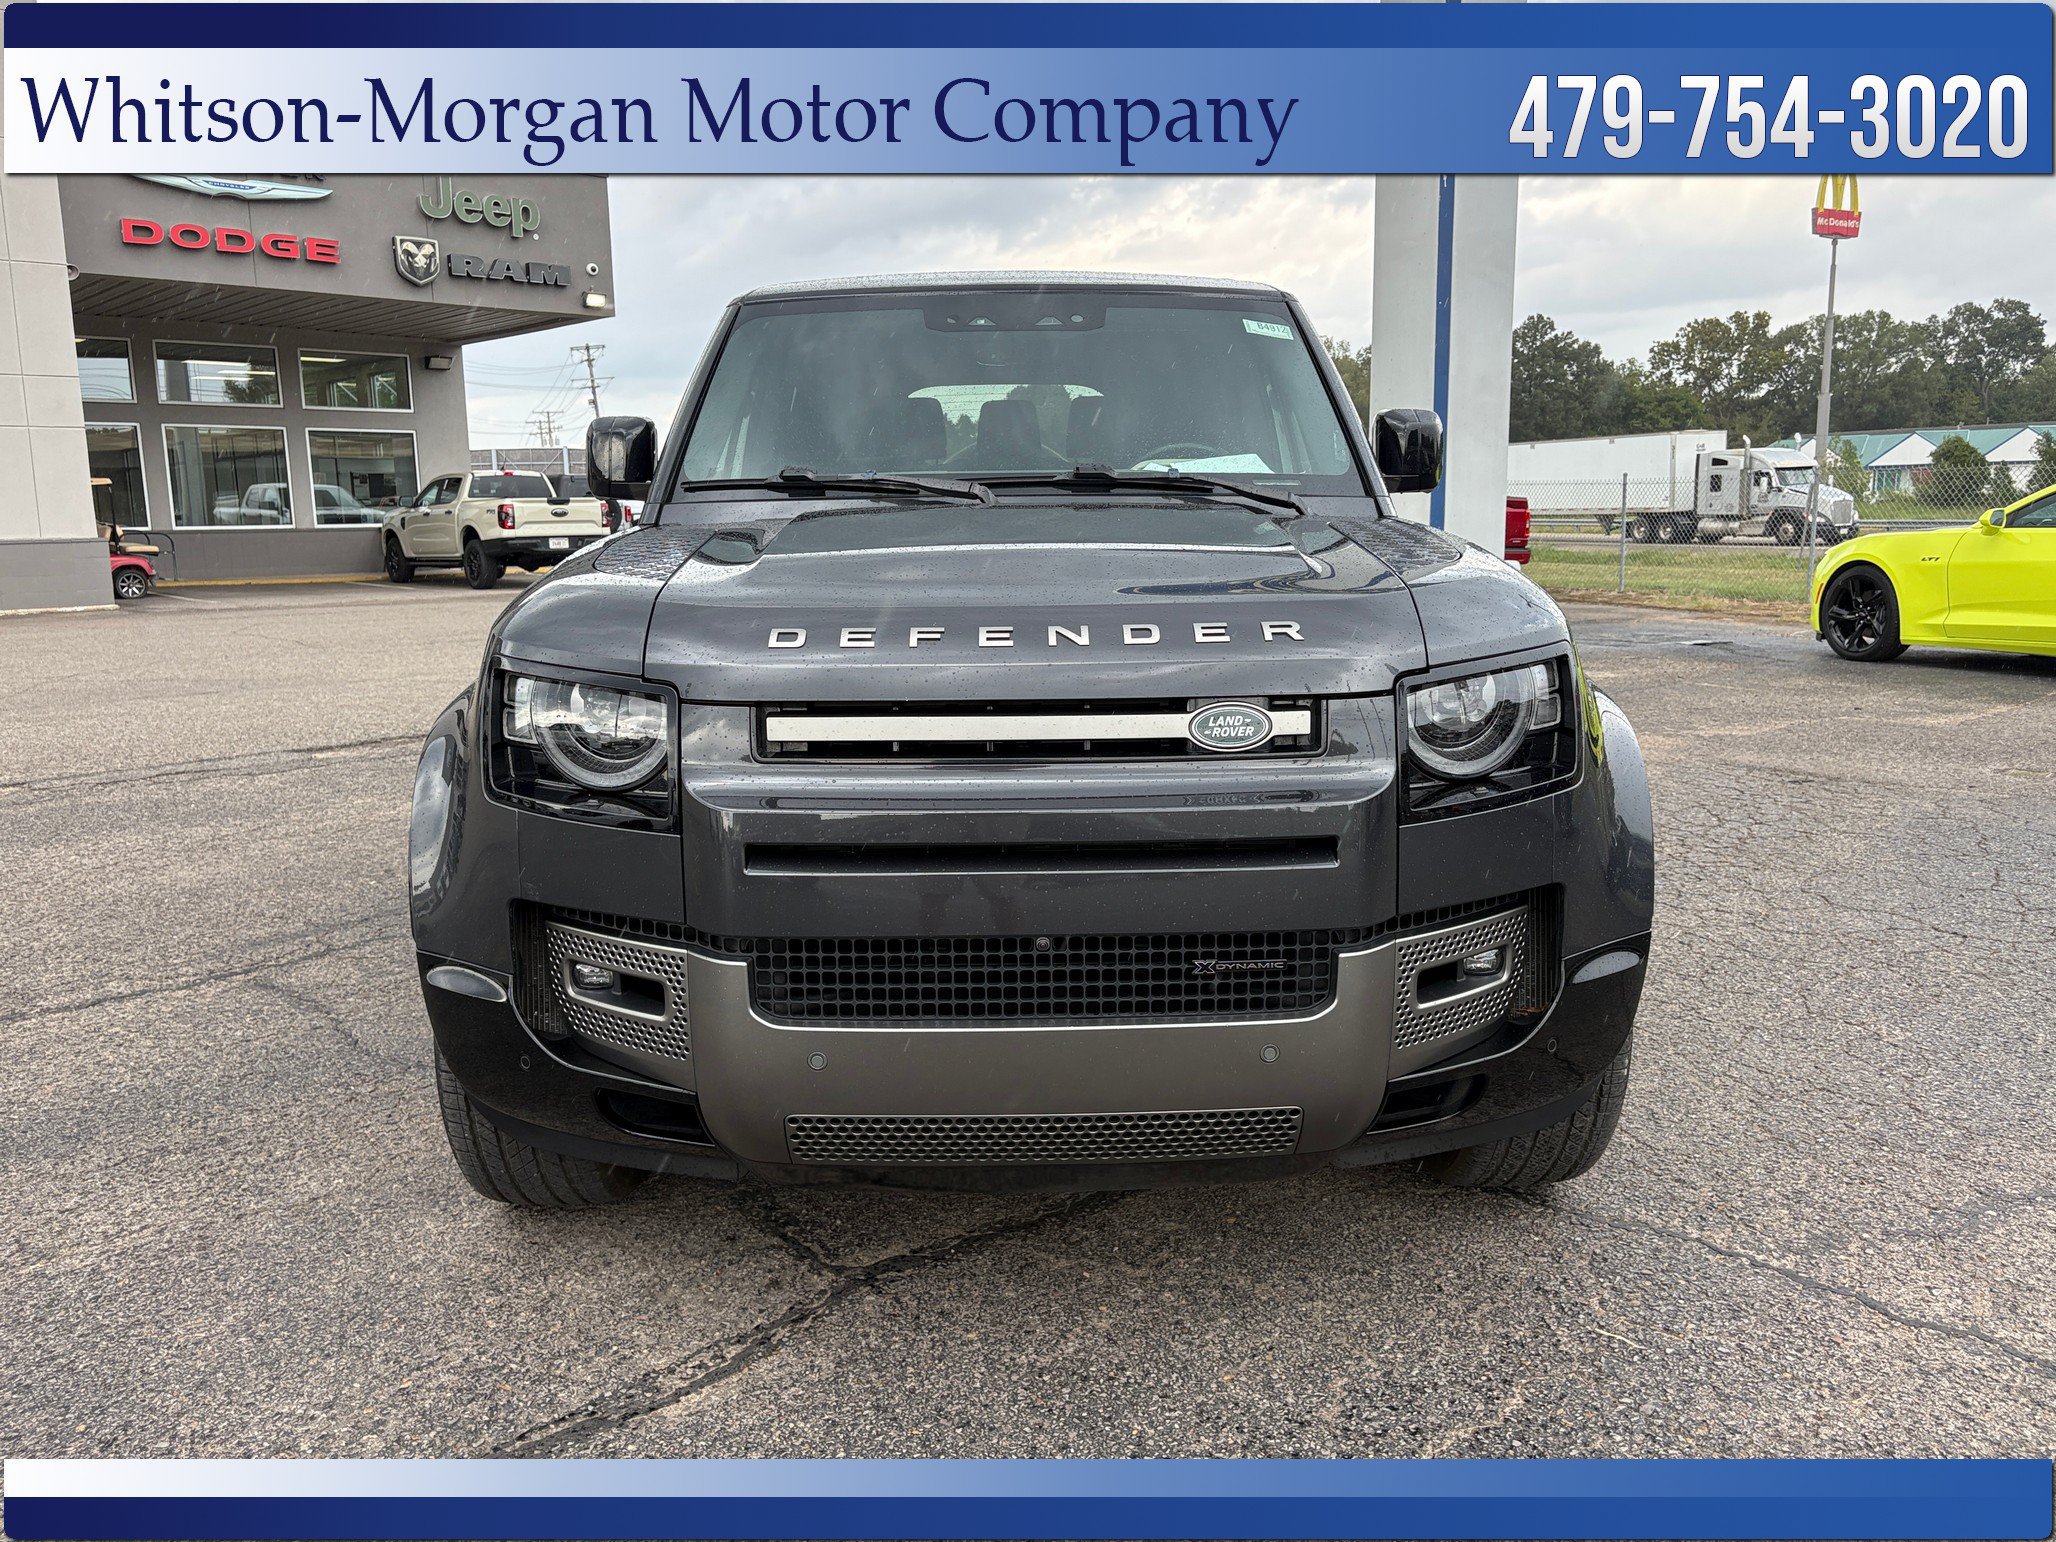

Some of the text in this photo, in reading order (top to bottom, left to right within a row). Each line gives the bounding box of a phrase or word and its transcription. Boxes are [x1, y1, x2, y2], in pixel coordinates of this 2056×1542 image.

[418, 176, 541, 238] Jeep
[1816, 217, 1859, 228] McDonald's
[121, 218, 341, 264] DODGE
[448, 254, 571, 286] RAM
[767, 620, 1306, 648] DEFENDER
[1216, 961, 1285, 971] DYNAMIC
